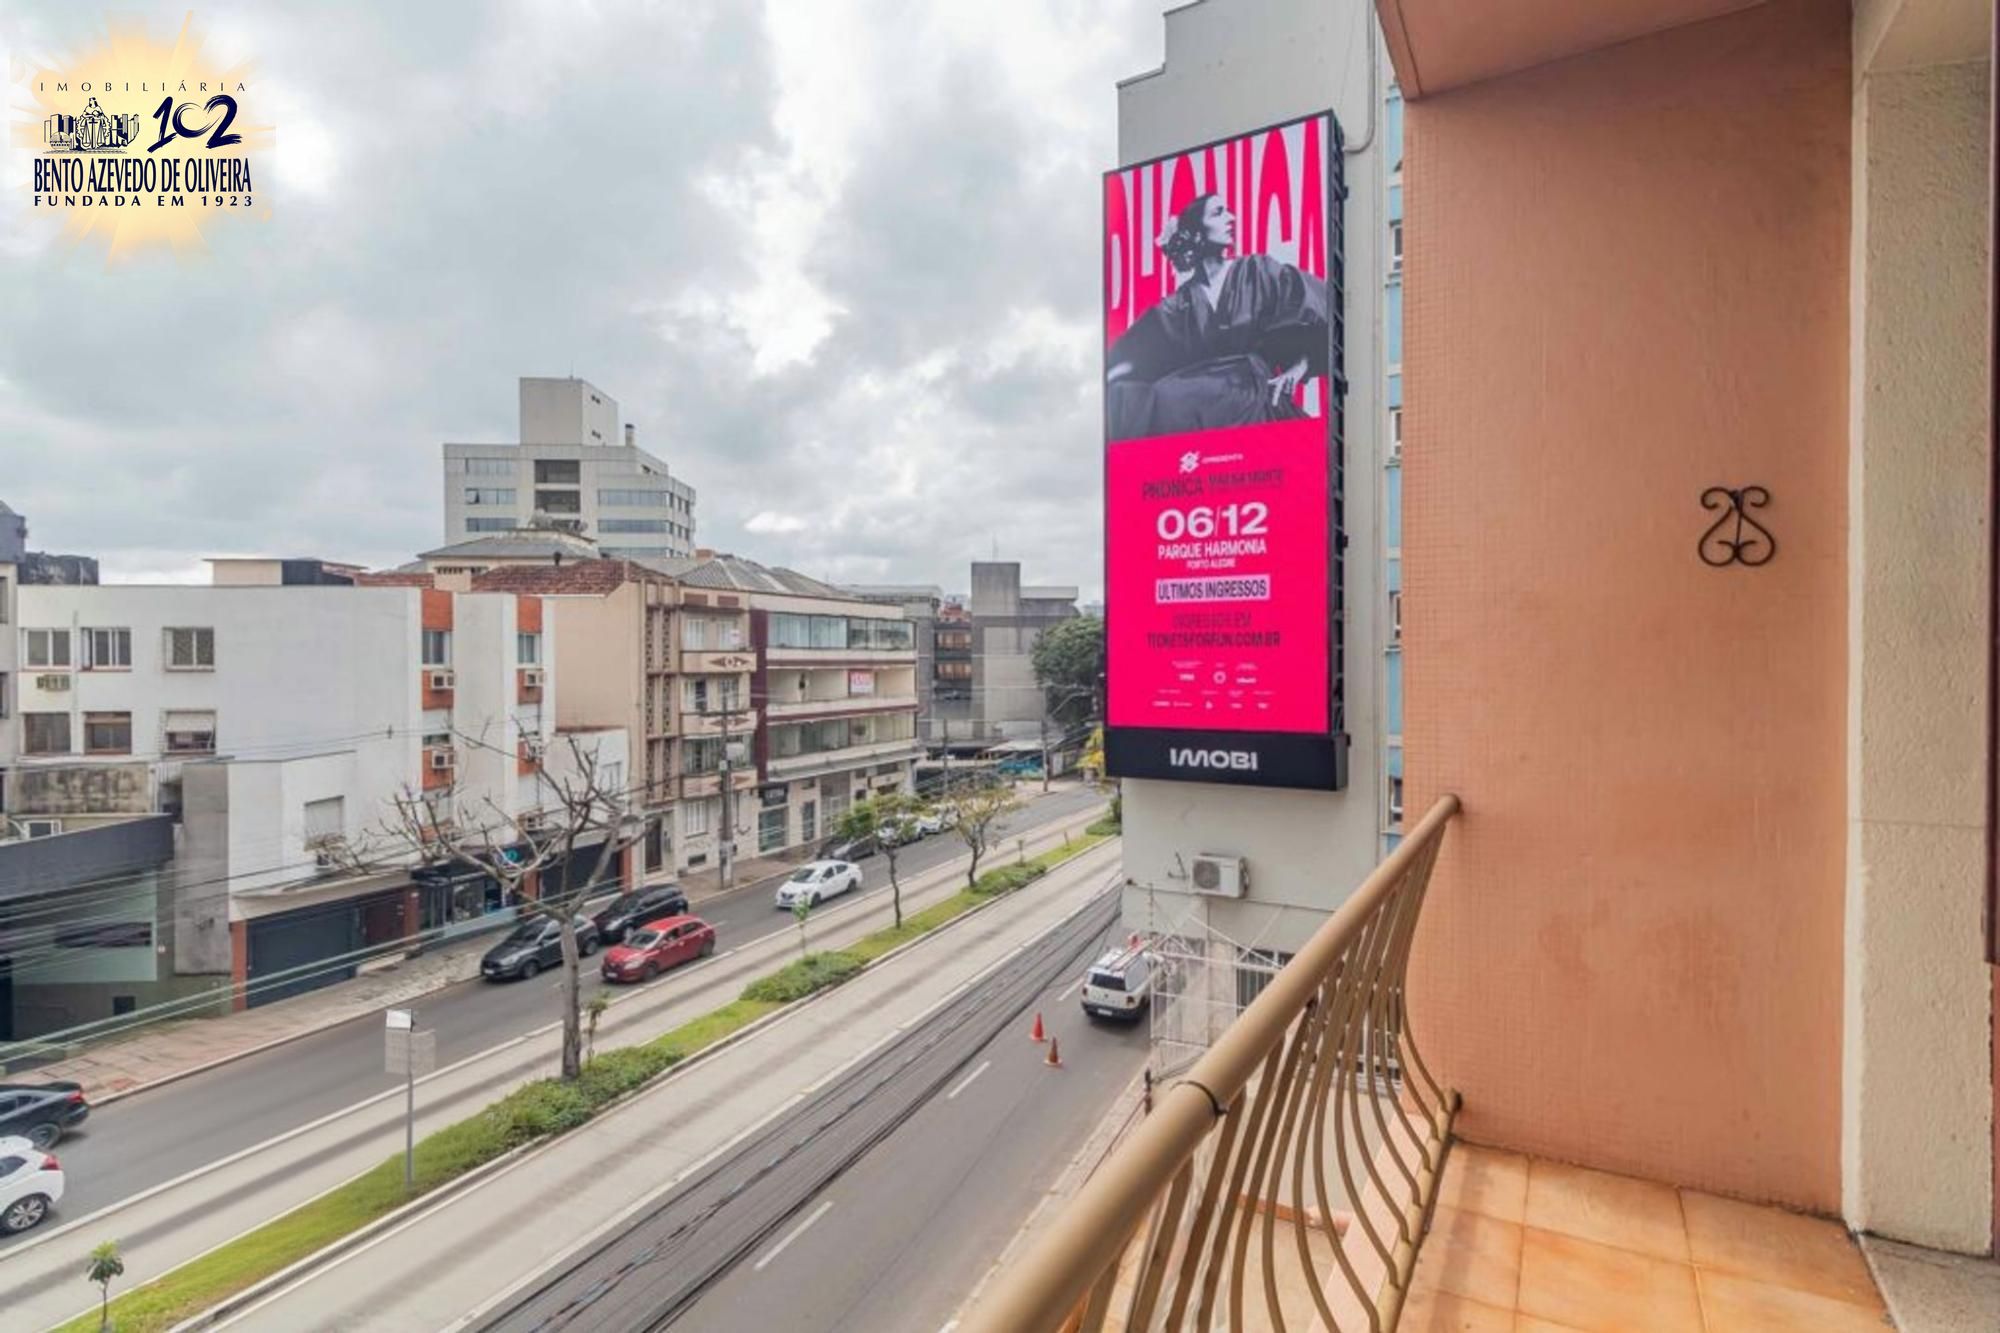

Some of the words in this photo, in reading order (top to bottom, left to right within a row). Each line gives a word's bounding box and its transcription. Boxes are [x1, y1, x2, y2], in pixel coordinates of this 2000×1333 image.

[1156, 502, 1269, 540] 06/12
[1158, 543, 1202, 560] PARQUE
[1205, 538, 1267, 557] HARMONIA
[1205, 579, 1267, 598] INGRESSOS
[1169, 748, 1259, 770] IMOBI
